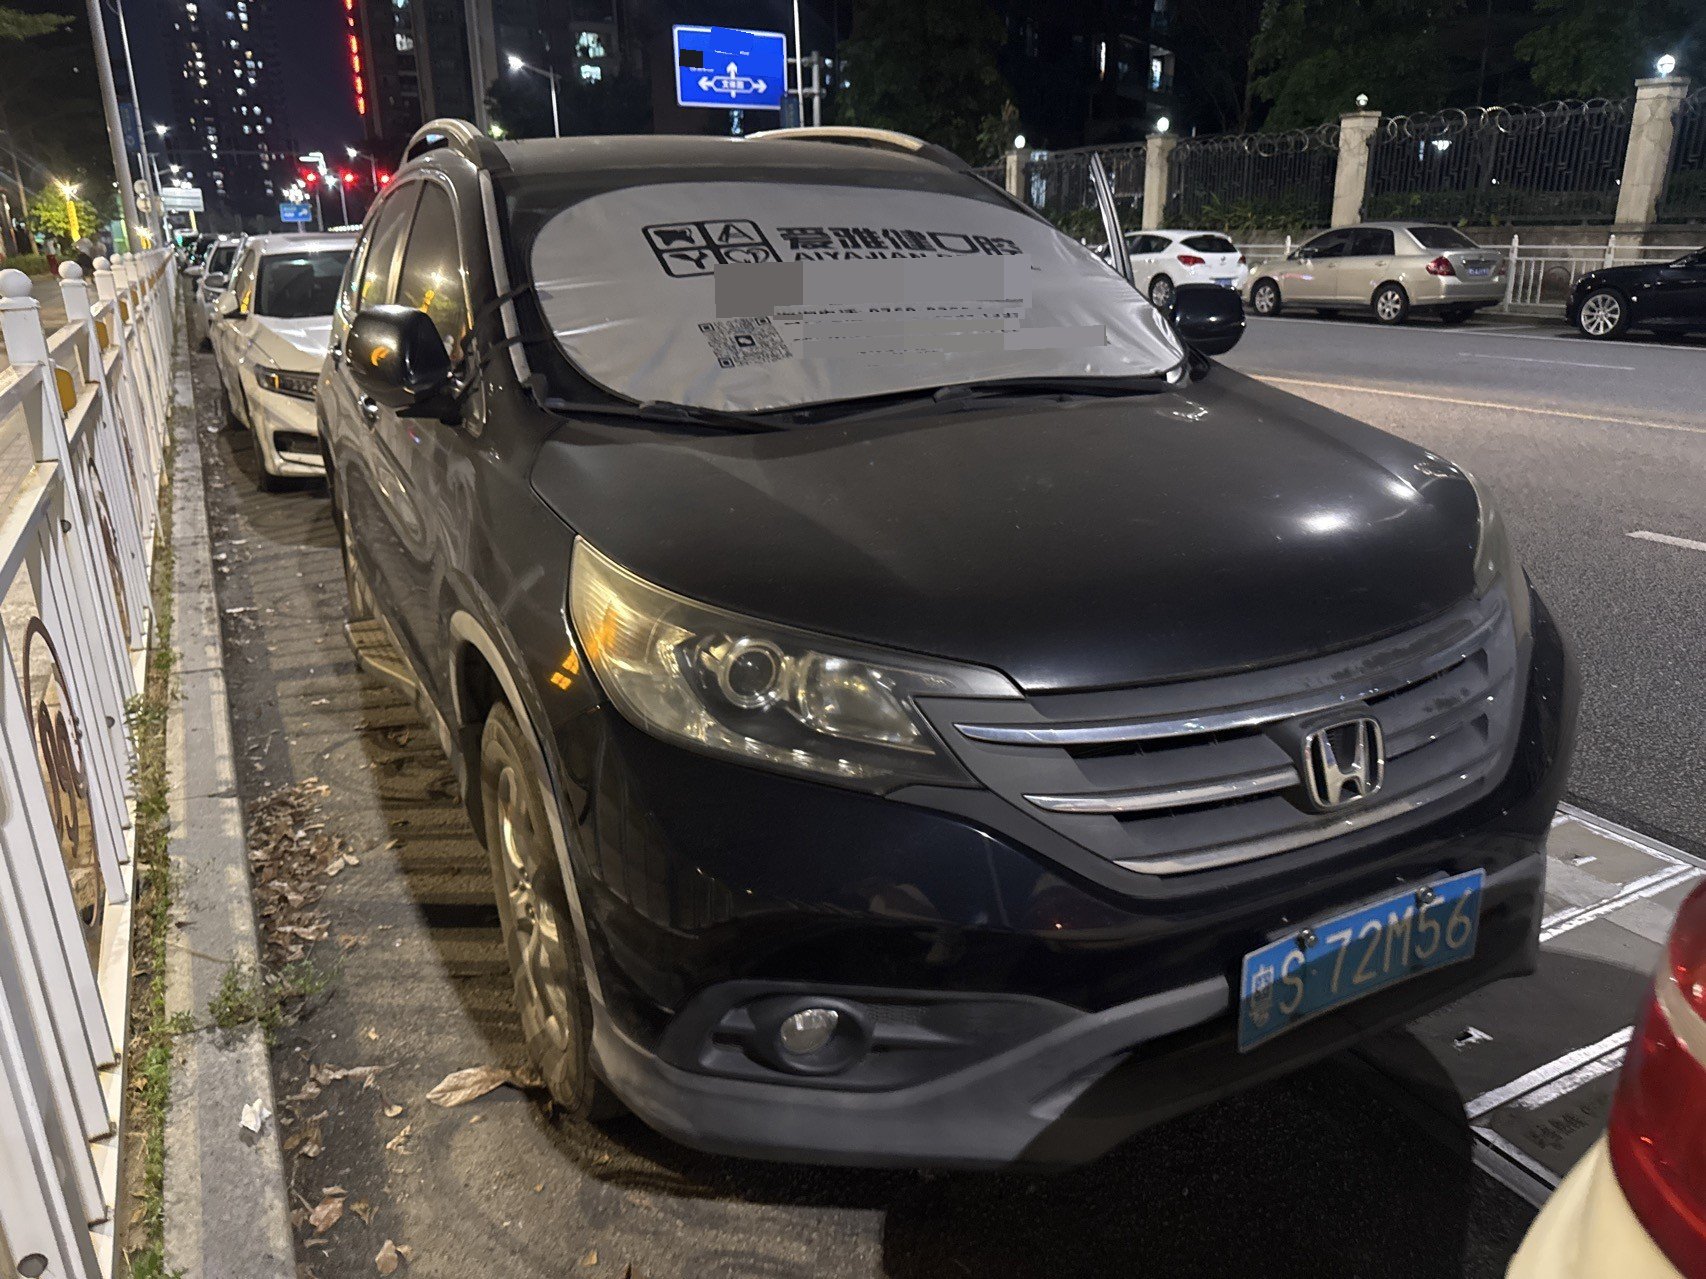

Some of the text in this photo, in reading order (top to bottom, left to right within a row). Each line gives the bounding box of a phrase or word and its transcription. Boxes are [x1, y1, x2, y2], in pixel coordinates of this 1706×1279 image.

[776, 227, 1023, 256] 爱雅健口腔
